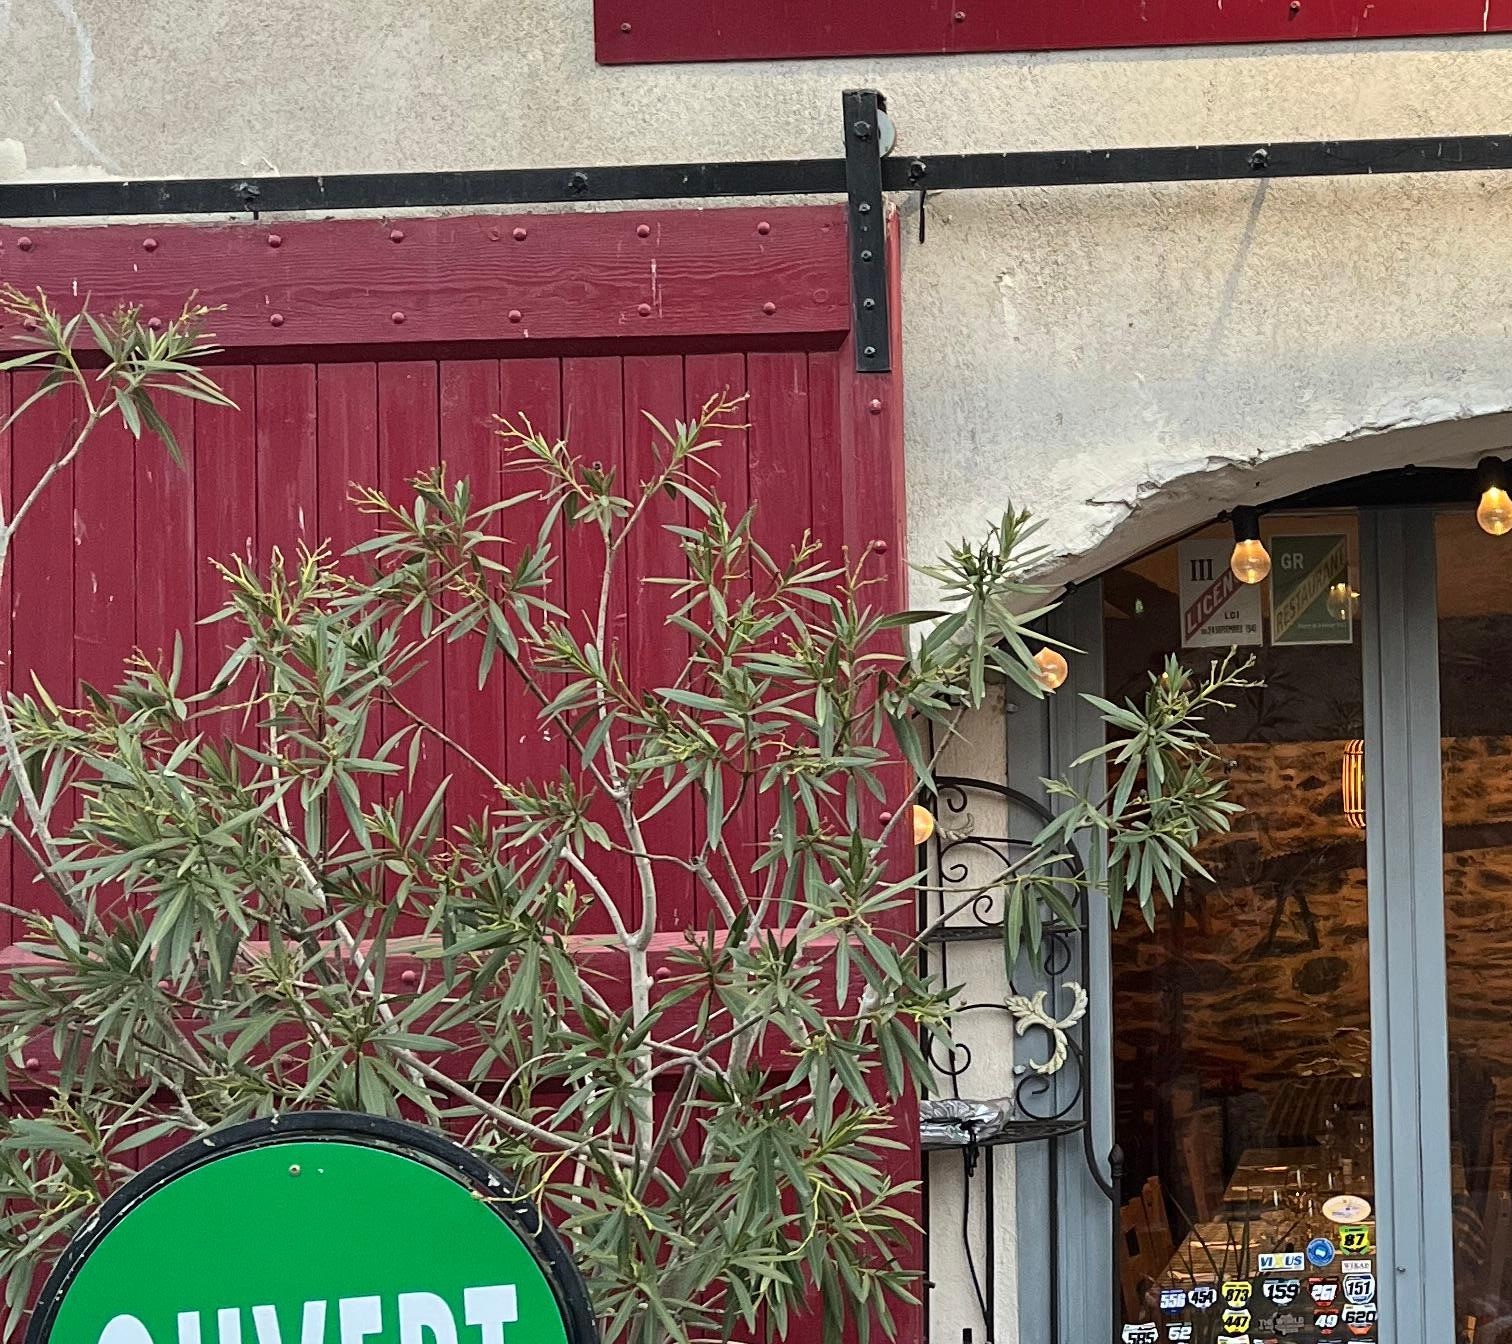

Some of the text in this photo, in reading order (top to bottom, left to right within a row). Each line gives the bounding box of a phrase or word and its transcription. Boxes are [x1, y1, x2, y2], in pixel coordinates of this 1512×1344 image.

[1281, 552, 1304, 569] GR
[1186, 569, 1239, 634] LICEN
[1344, 1233, 1365, 1246] 87
[1267, 1284, 1299, 1299] 159
[1348, 1282, 1370, 1295] 151
[1224, 1316, 1248, 1327] 447
[1315, 1315, 1338, 1327] 49
[1346, 1311, 1376, 1324] 620
